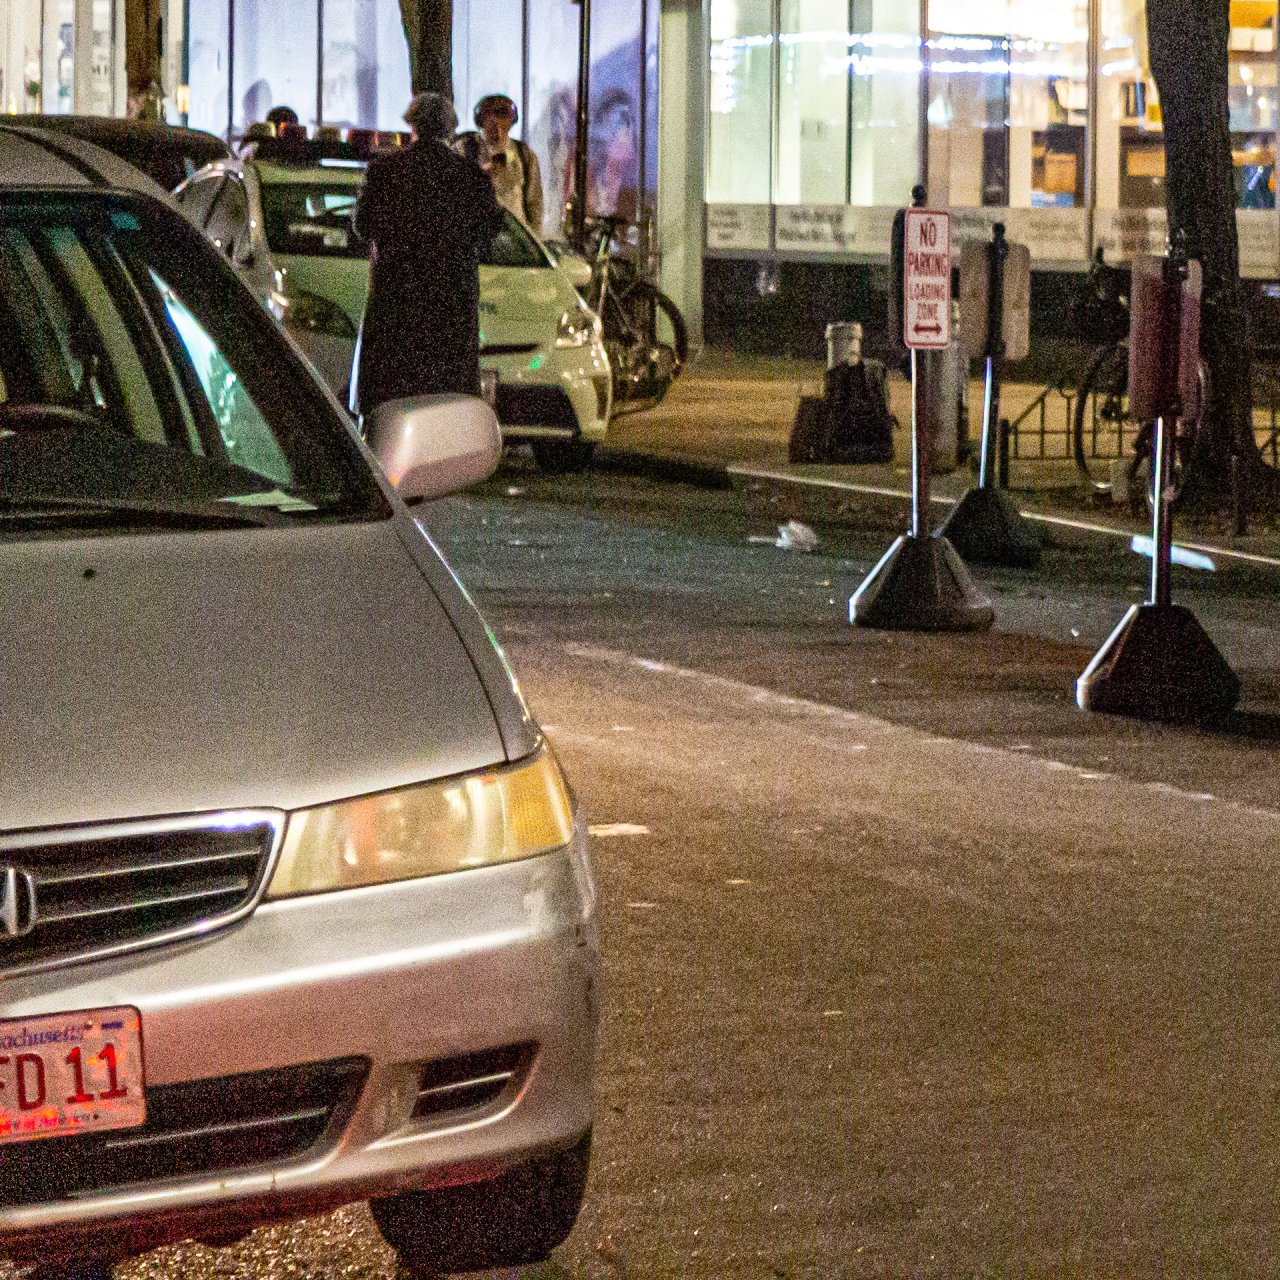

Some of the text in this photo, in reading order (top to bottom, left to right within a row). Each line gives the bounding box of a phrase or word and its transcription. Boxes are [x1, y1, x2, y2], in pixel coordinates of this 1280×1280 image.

[919, 221, 938, 247] NO
[906, 252, 949, 278] PARKING
[909, 282, 946, 301] LOADING
[916, 303, 939, 320] ZONE
[0, 1025, 84, 1049] achusetts
